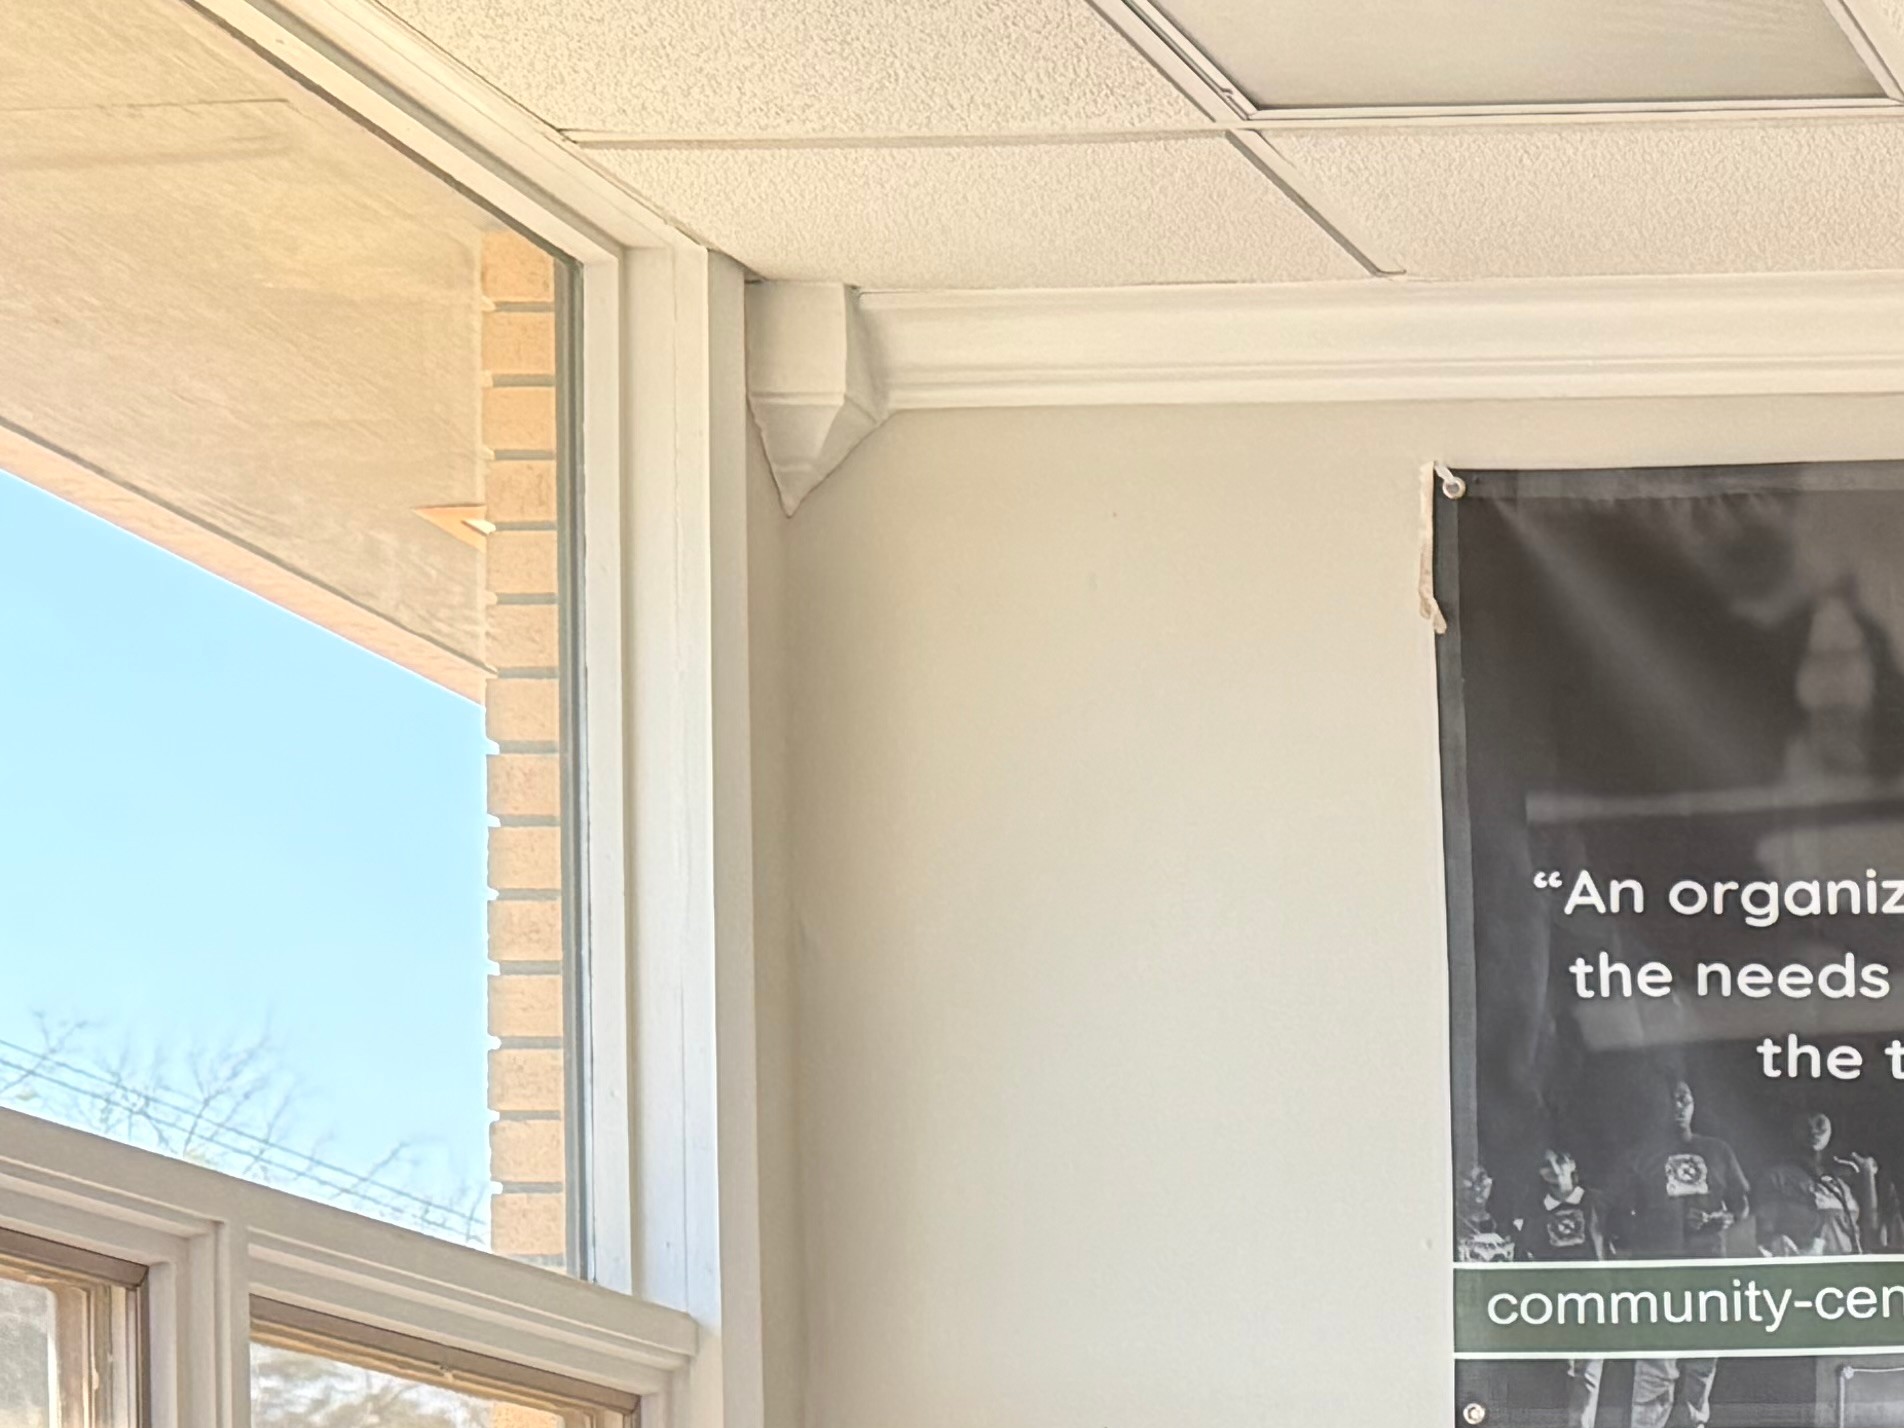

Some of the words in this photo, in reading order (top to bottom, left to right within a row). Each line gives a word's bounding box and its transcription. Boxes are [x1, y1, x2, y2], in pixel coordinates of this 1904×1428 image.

[1534, 870, 1643, 914] “An
[1569, 952, 1672, 998] the
[1698, 953, 1889, 998] needs
[1757, 1034, 1862, 1079] the
